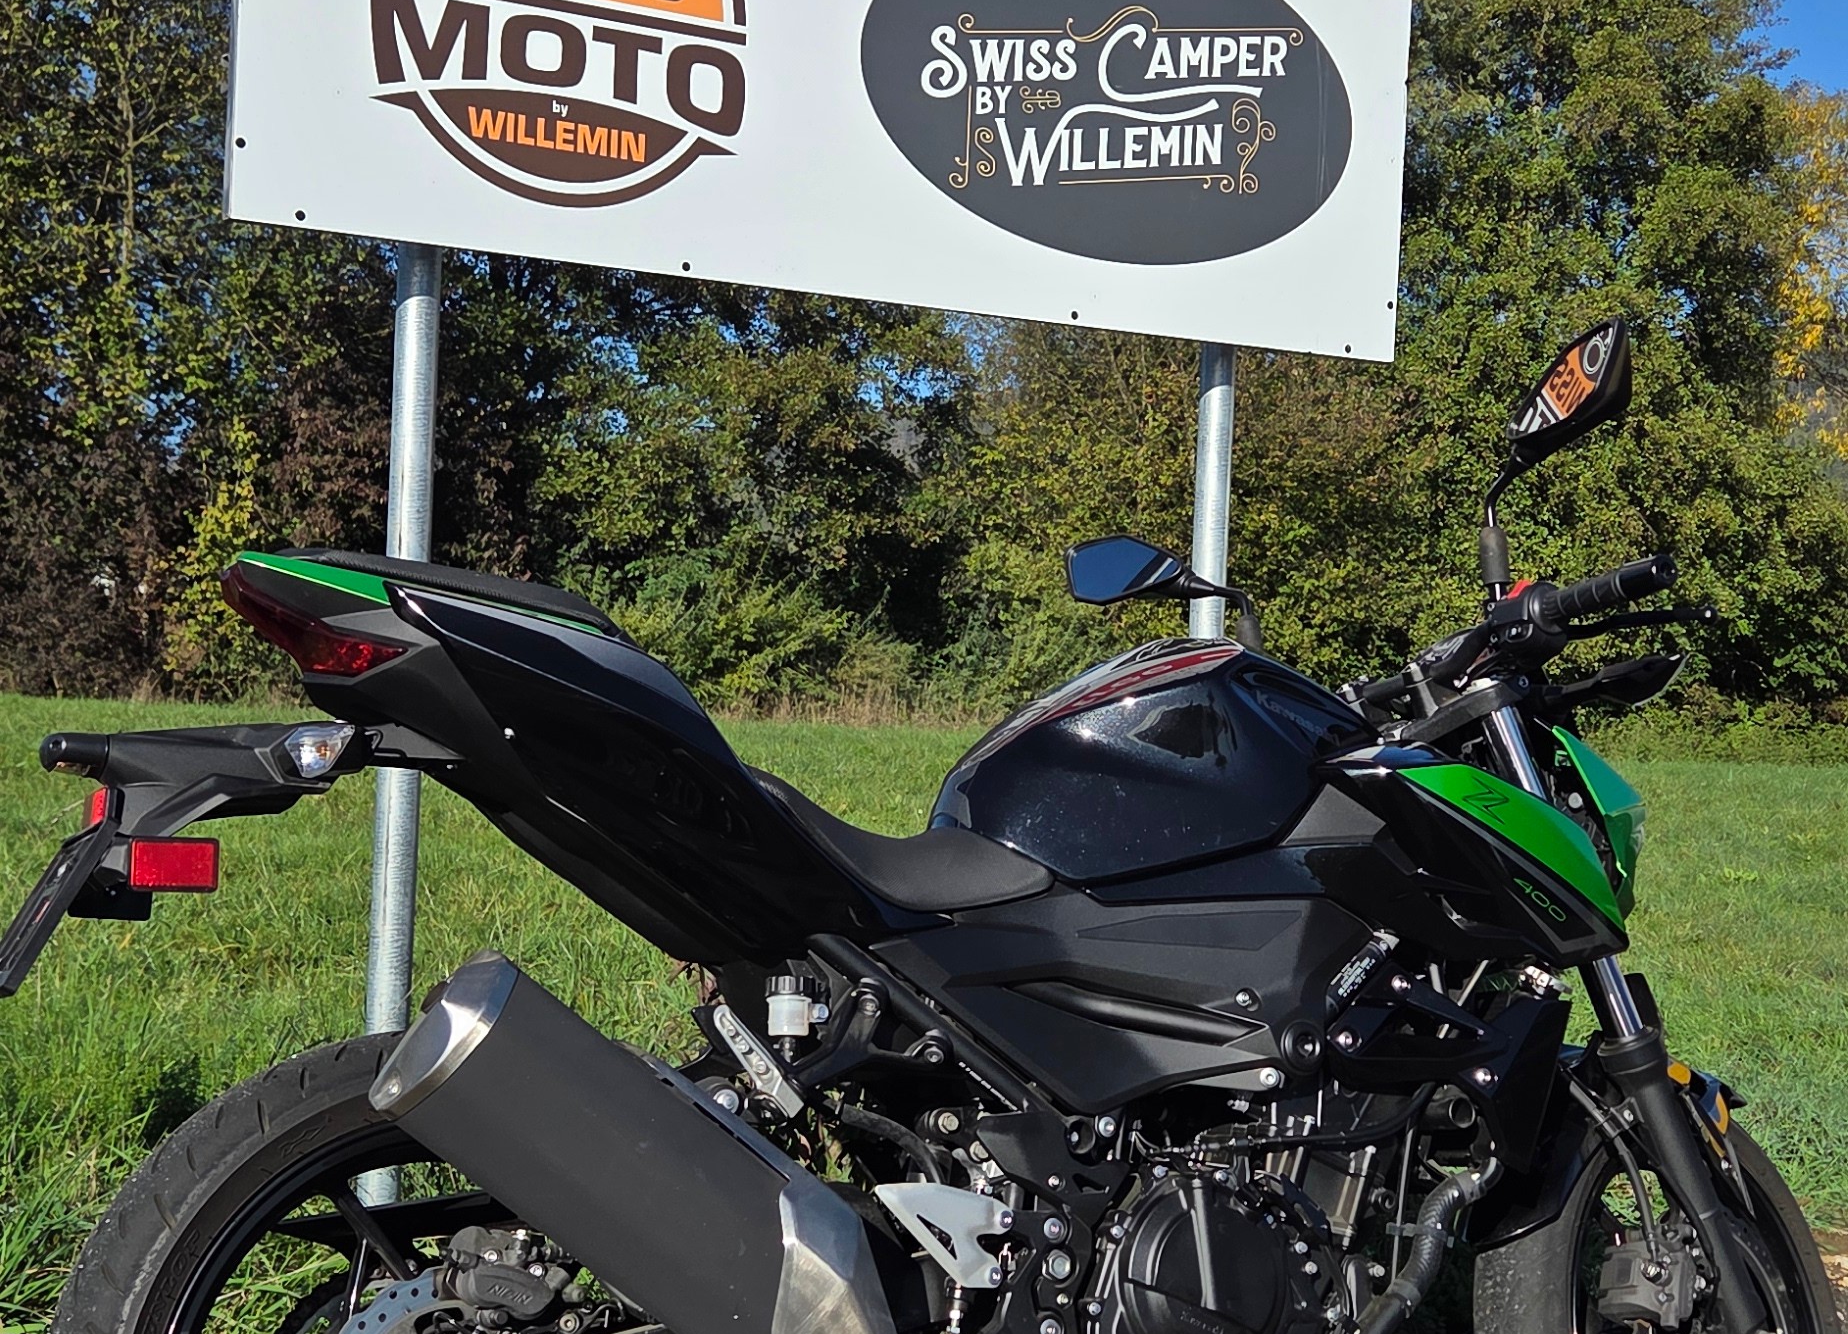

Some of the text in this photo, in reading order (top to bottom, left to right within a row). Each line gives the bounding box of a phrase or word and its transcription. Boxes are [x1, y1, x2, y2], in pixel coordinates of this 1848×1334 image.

[552, 99, 569, 117] by
[974, 85, 1011, 115] BY
[468, 105, 647, 162] WILLEMIN
[994, 98, 1223, 186] WILLEMIN
[1513, 877, 1567, 922] 400
